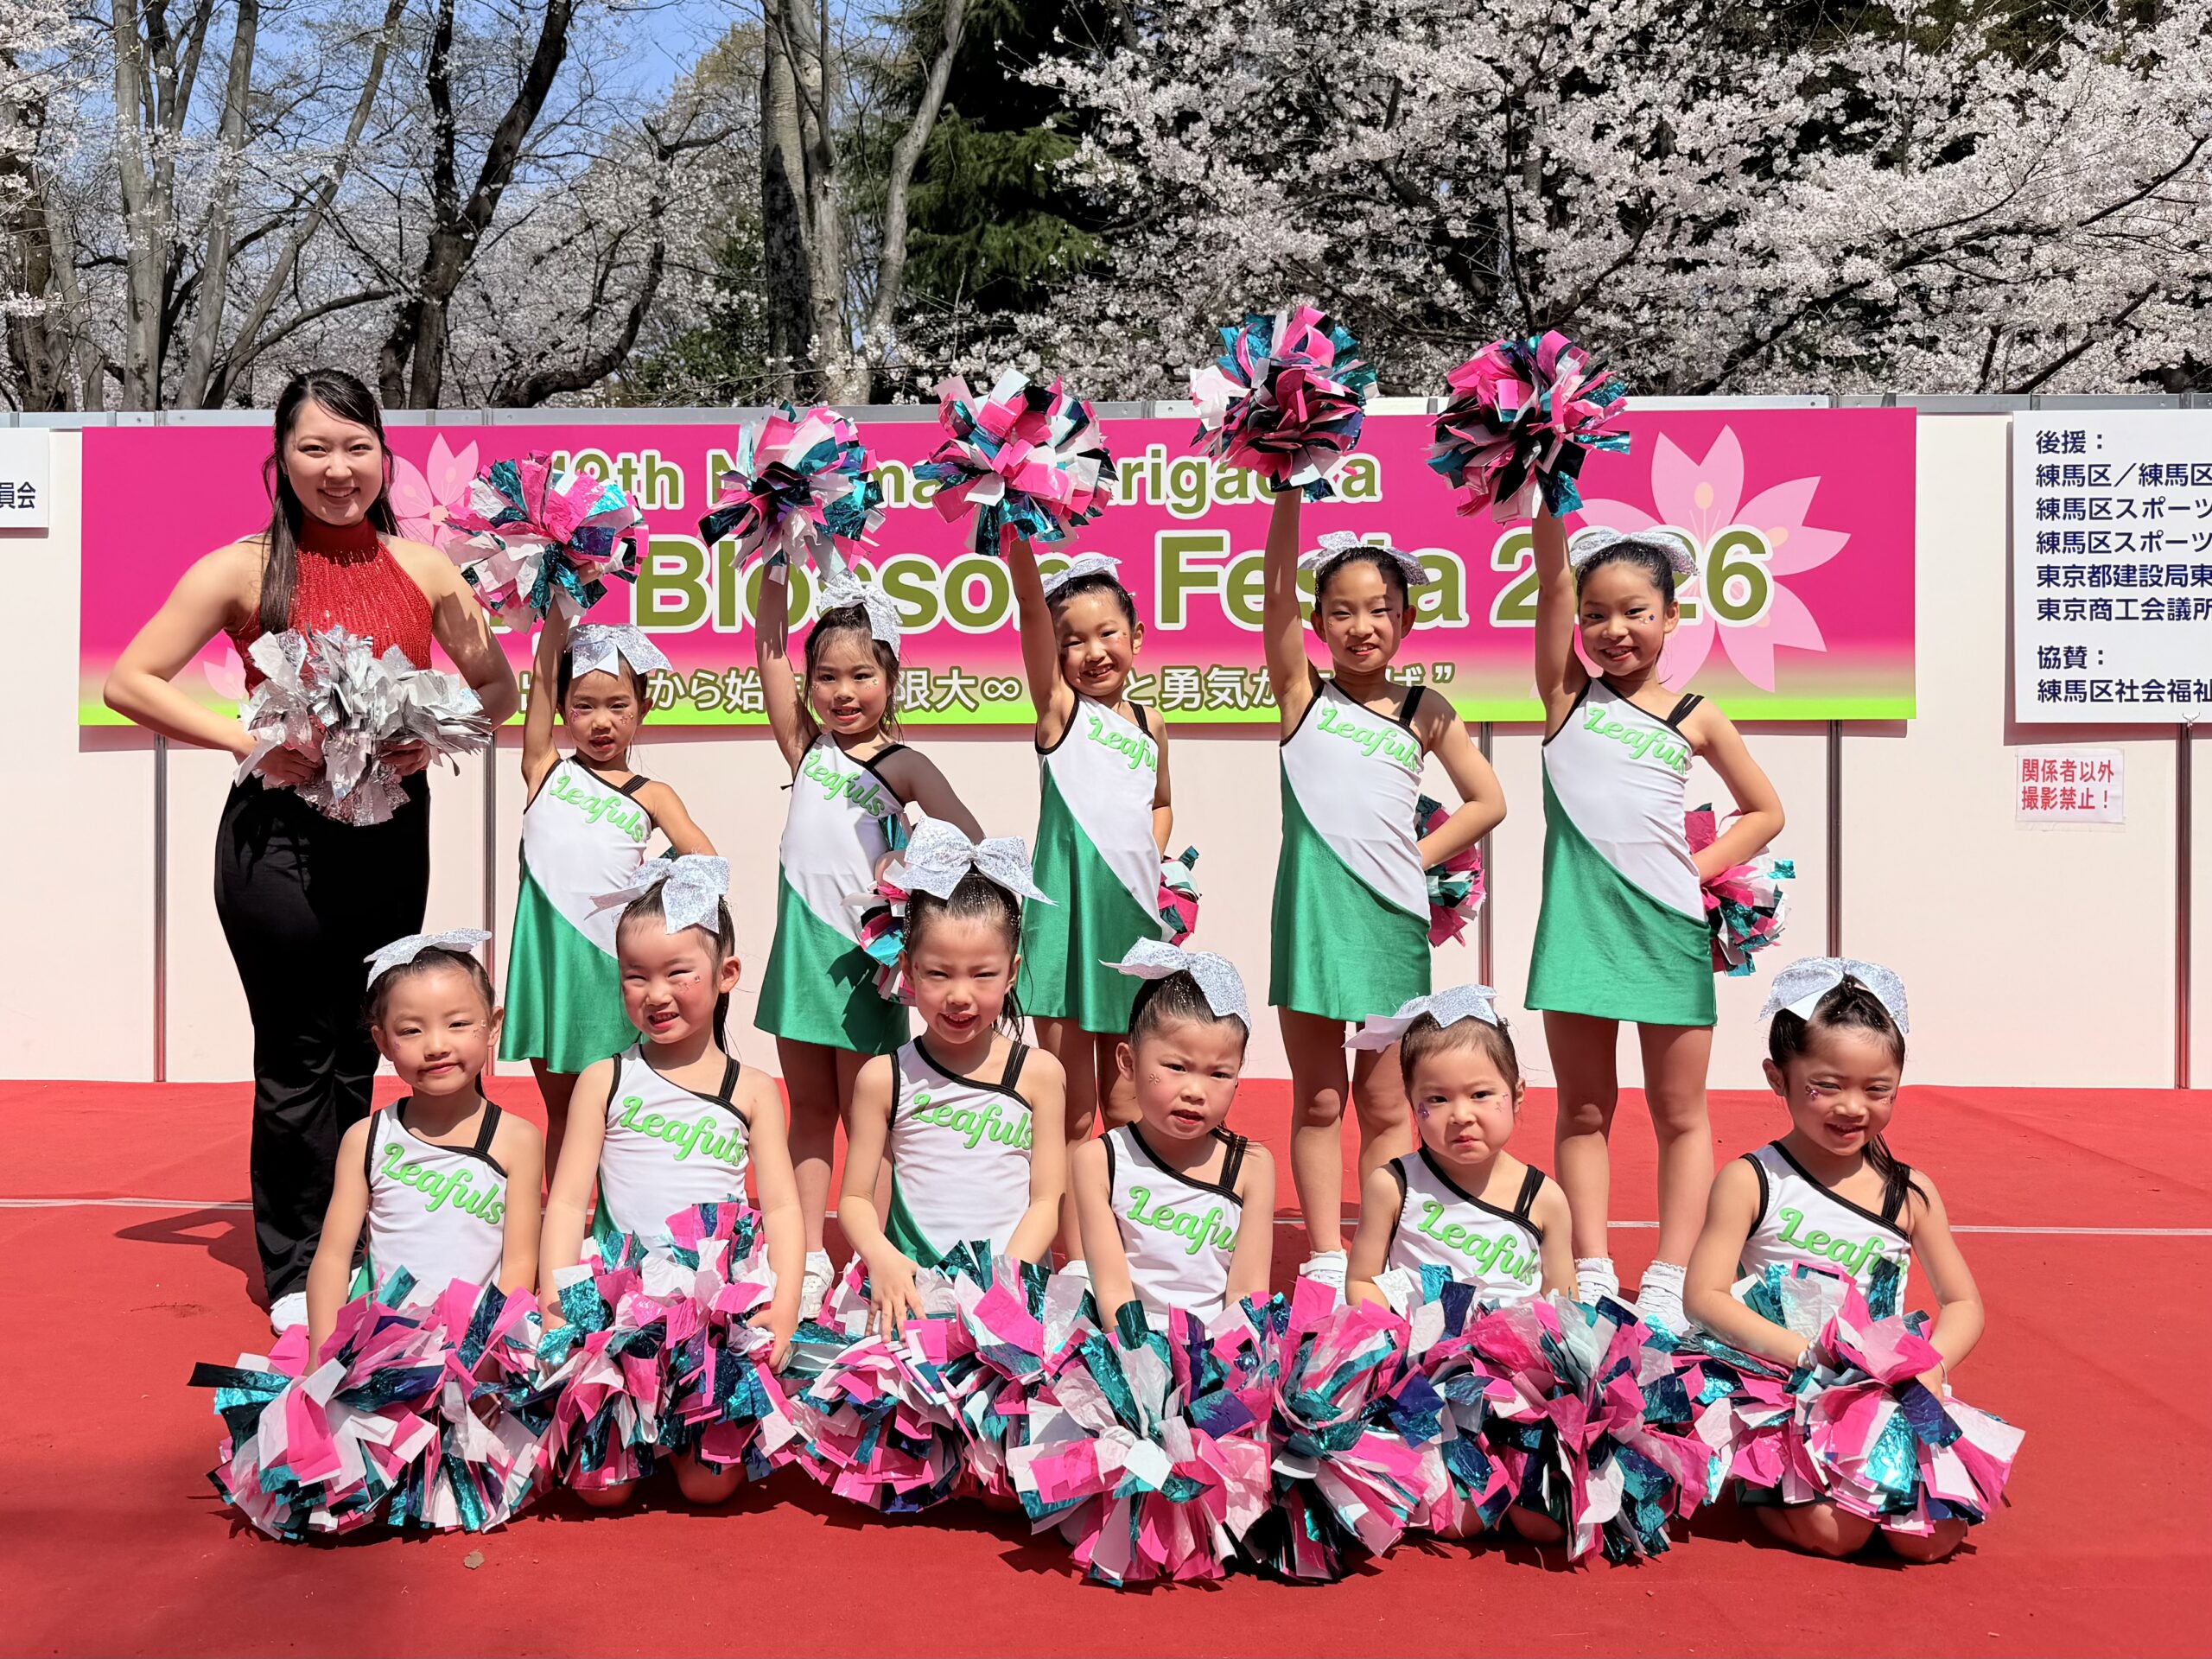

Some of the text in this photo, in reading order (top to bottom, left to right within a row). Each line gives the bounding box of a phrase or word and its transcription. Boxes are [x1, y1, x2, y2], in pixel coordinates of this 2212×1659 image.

[2035, 429, 2103, 454] 後援：
[2035, 462, 2212, 488] 練馬区／練馬区
[0, 480, 36, 510] 員会
[2035, 495, 2212, 522] 練馬区スポーツ
[2035, 529, 2212, 555] 練馬区スポーツ
[1489, 524, 1774, 627] 26
[2036, 563, 2212, 588] 東京都建設局東
[2036, 597, 2212, 621] 東京商工会議所
[2037, 645, 2104, 670] 協賛：
[2037, 678, 2212, 703] 練馬区社会福祉
[804, 750, 886, 817] Leafuls
[2022, 758, 2114, 783] 関係者以外
[550, 775, 644, 843] Leafuls
[2021, 785, 2108, 810] 撮影禁止！
[380, 1142, 505, 1225] Leafuls
[1126, 1185, 1239, 1255] Leafu
[1777, 1207, 1909, 1279] Leaf
